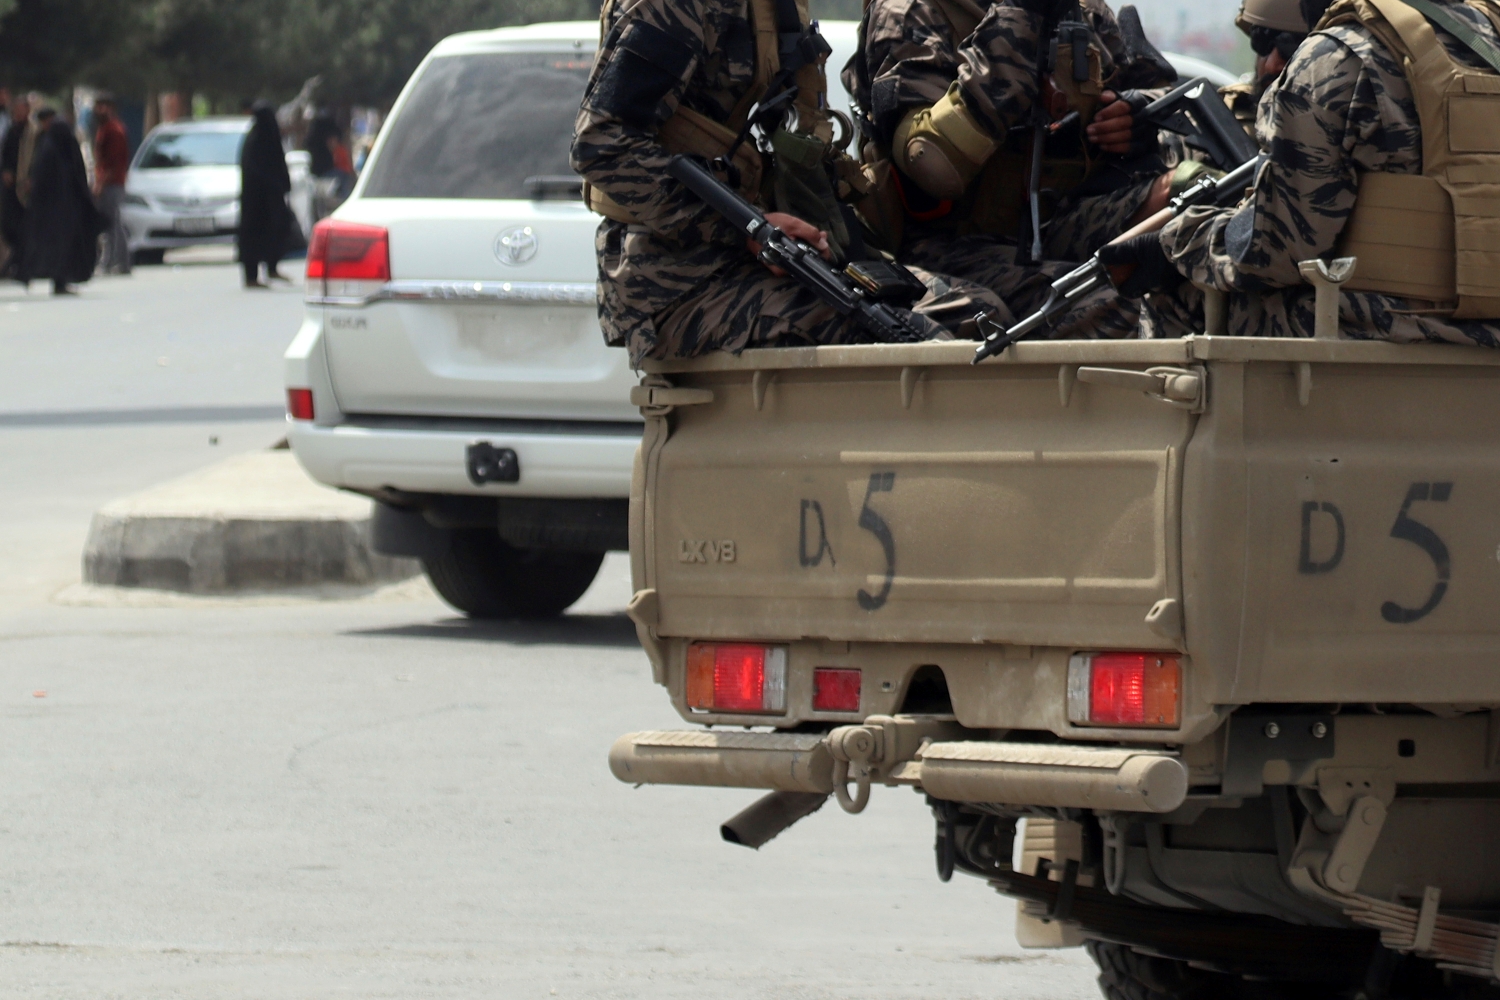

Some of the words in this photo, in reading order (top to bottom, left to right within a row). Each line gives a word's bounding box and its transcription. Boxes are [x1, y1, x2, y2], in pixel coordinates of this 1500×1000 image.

[680, 539, 707, 564] LX
[709, 539, 737, 564] V8
[857, 472, 896, 611] 5
[1299, 500, 1346, 574] D
[1380, 481, 1455, 624] 5
